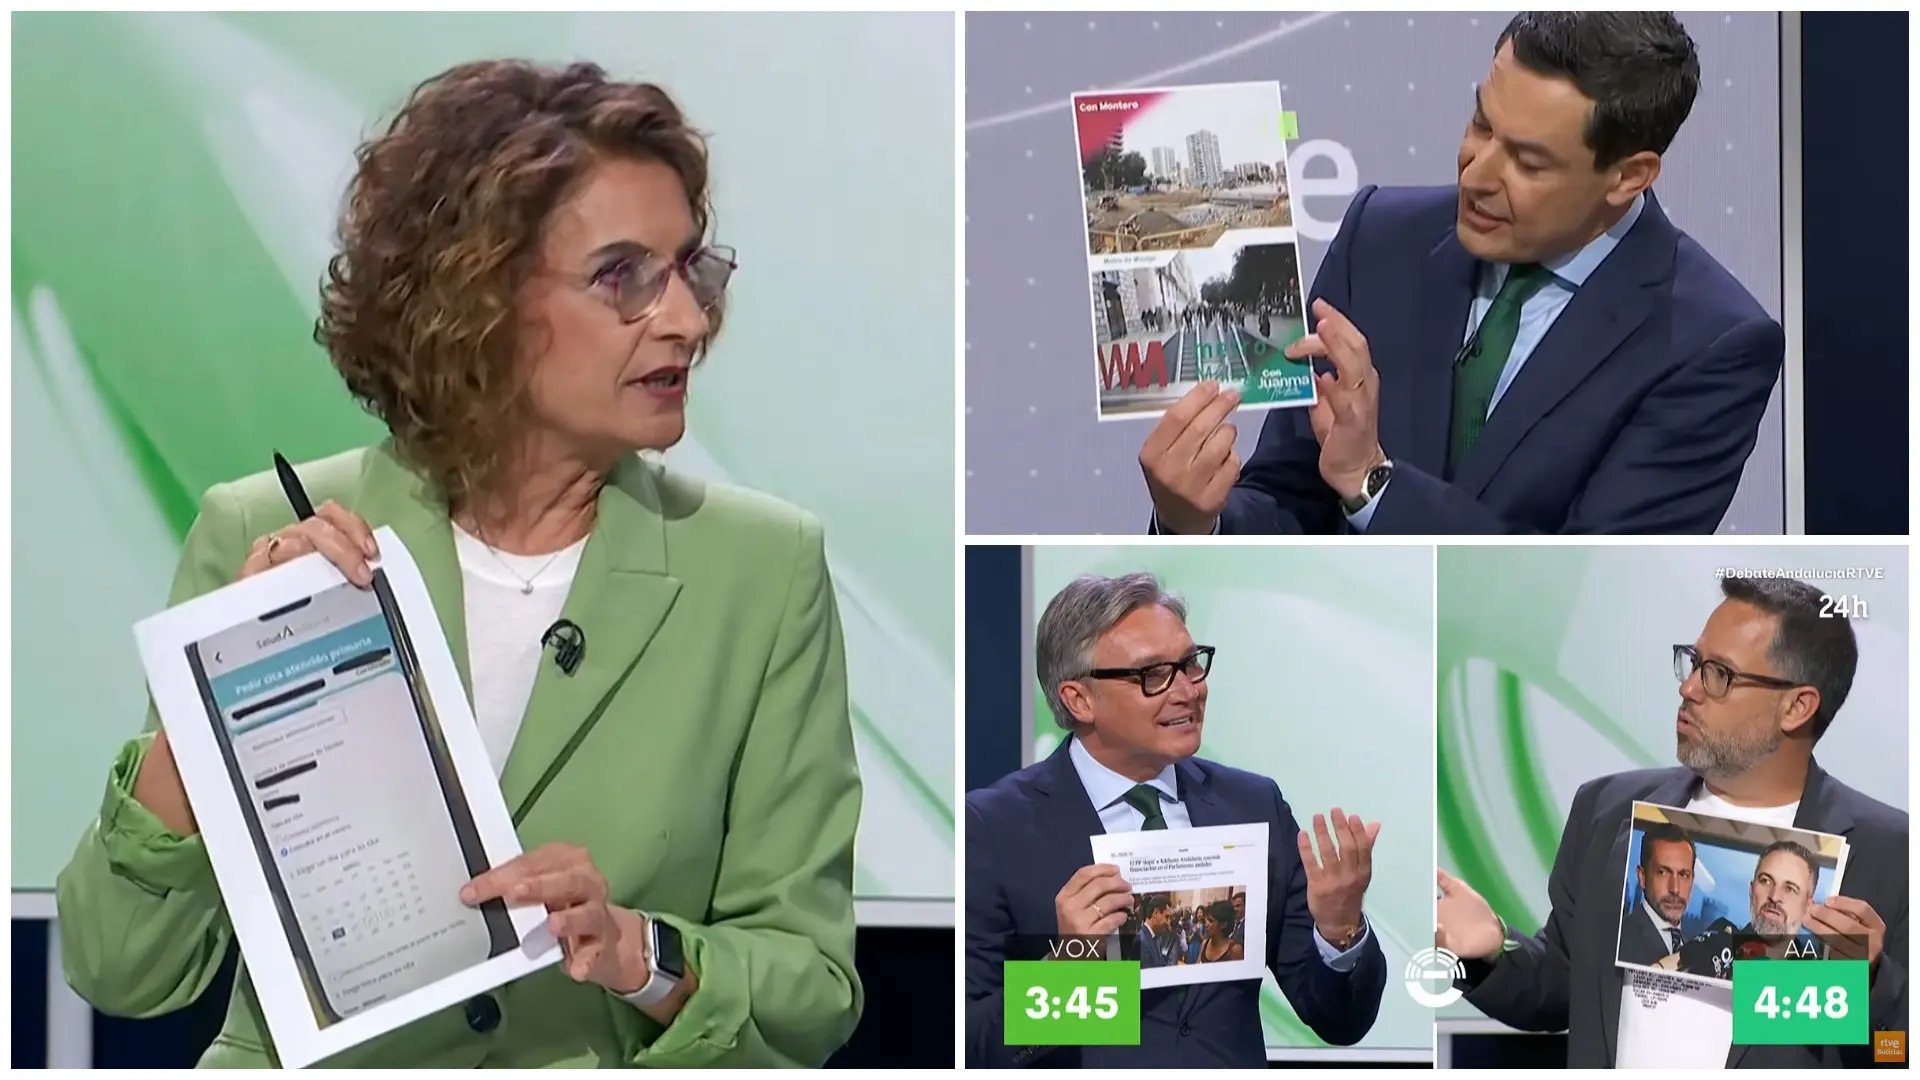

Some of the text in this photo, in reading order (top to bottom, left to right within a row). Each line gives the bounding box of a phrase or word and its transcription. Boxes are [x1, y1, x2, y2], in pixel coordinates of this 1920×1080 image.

[1079, 100, 1139, 112] Con Montero
[1258, 375, 1309, 390] Juanma
[235, 637, 372, 696] Pedir cita atención primaria
